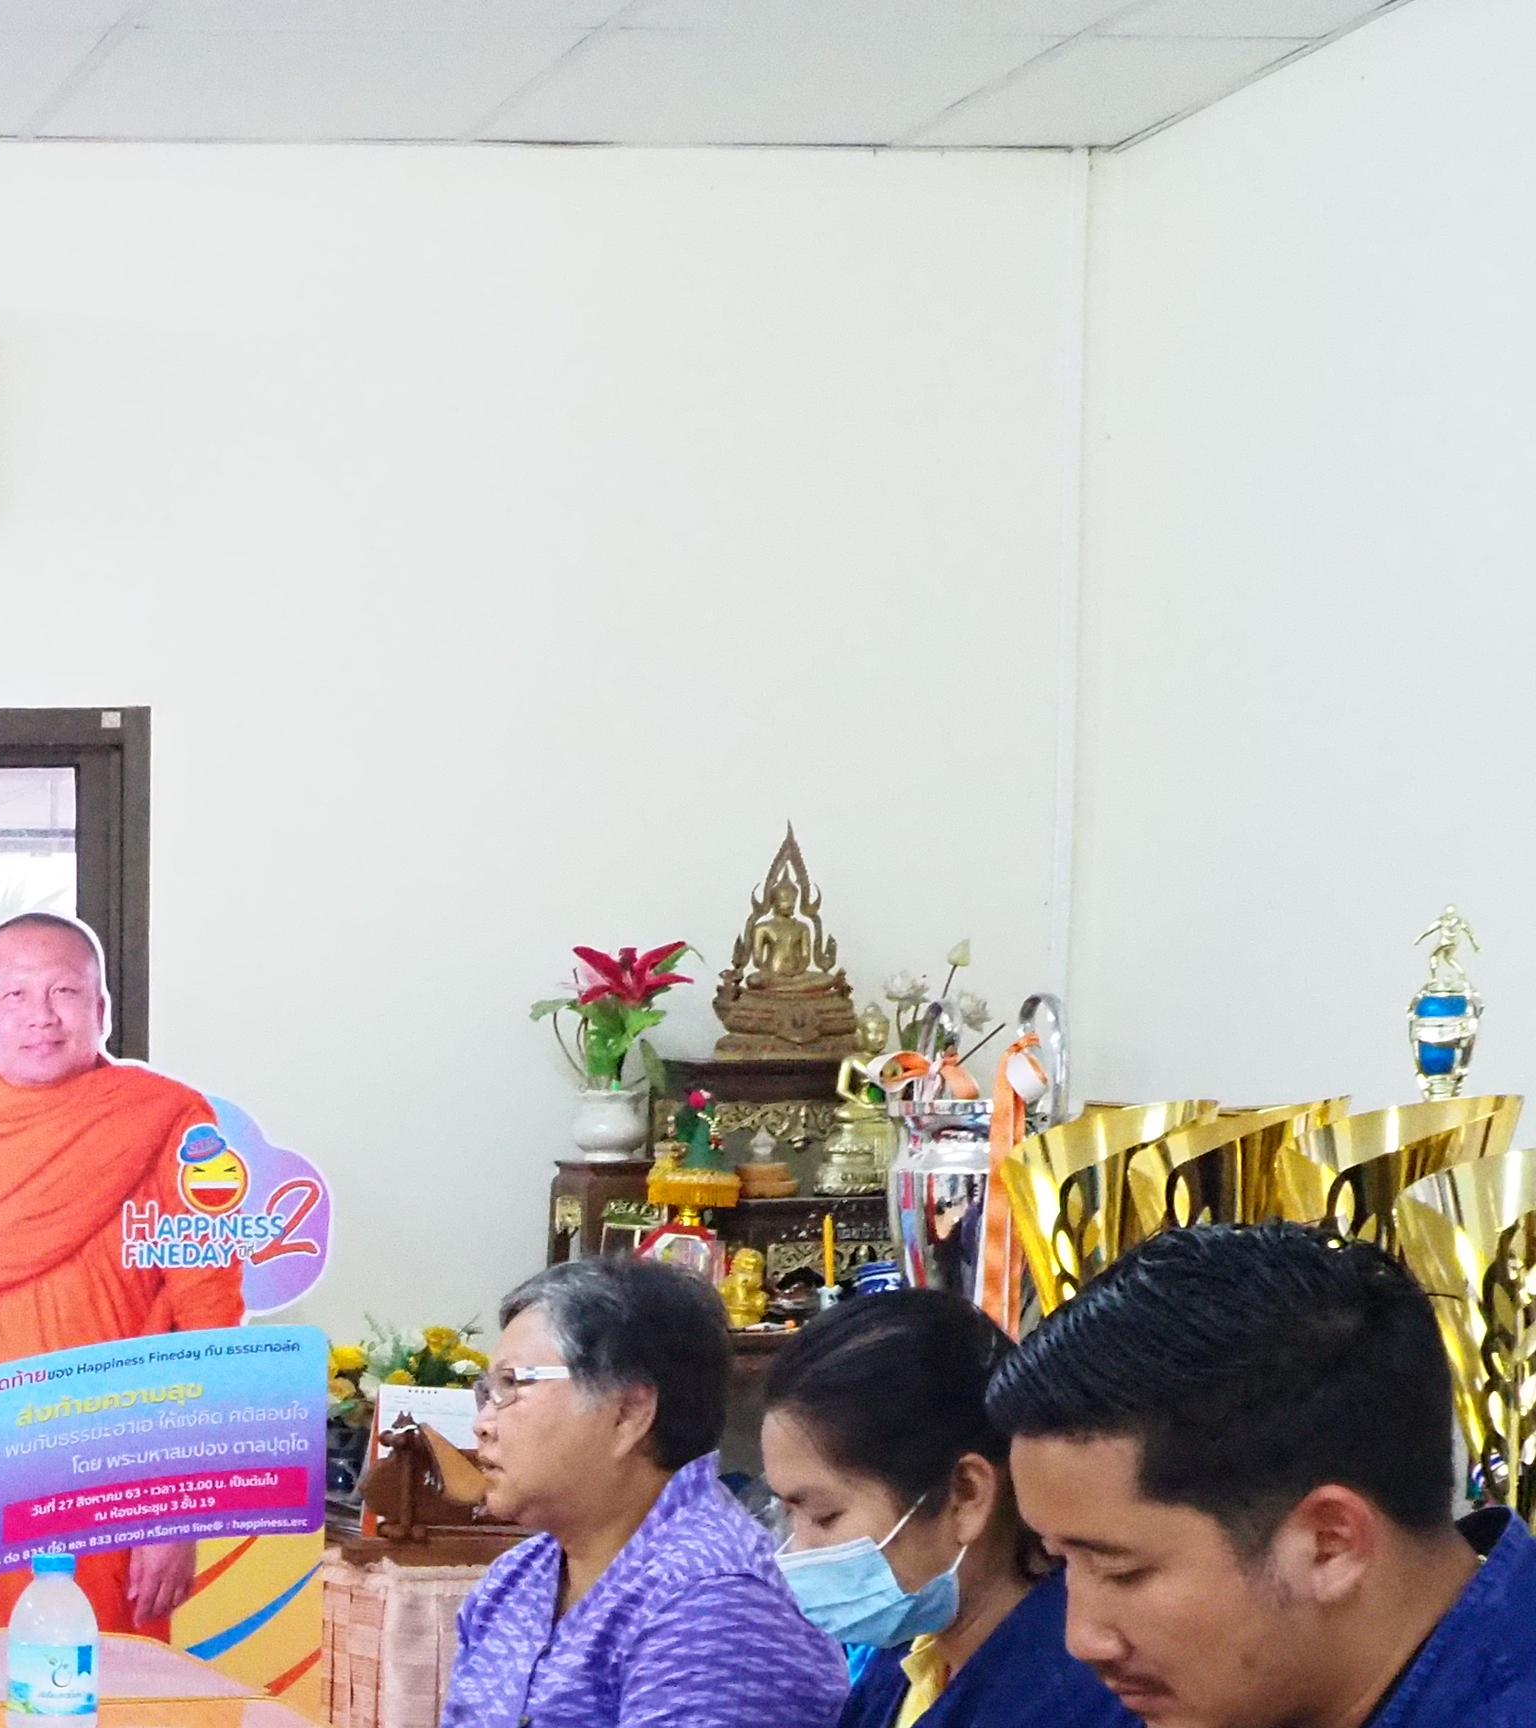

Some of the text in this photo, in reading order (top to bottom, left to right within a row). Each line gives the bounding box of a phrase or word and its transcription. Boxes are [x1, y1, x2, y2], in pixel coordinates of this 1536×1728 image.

[77, 1355, 145, 1376] Happiness
[149, 1345, 201, 1363] Fineday
[205, 1343, 223, 1357] กับ
[73, 1456, 102, 1475] โดย
[107, 1443, 228, 1469] พระมหาสมปอง
[31, 1498, 56, 1516] วันที่
[58, 1499, 73, 1511] 27
[76, 1491, 123, 1508] สิงหาคม
[125, 1488, 141, 1499] 63
[150, 1485, 176, 1496] เวลา
[179, 1479, 213, 1492] 13.00
[215, 1479, 227, 1489] น.
[110, 1501, 168, 1519] ห้องประชุม
[170, 1501, 179, 1511] 3
[199, 1497, 215, 1508] 19
[90, 1535, 111, 1547] 833
